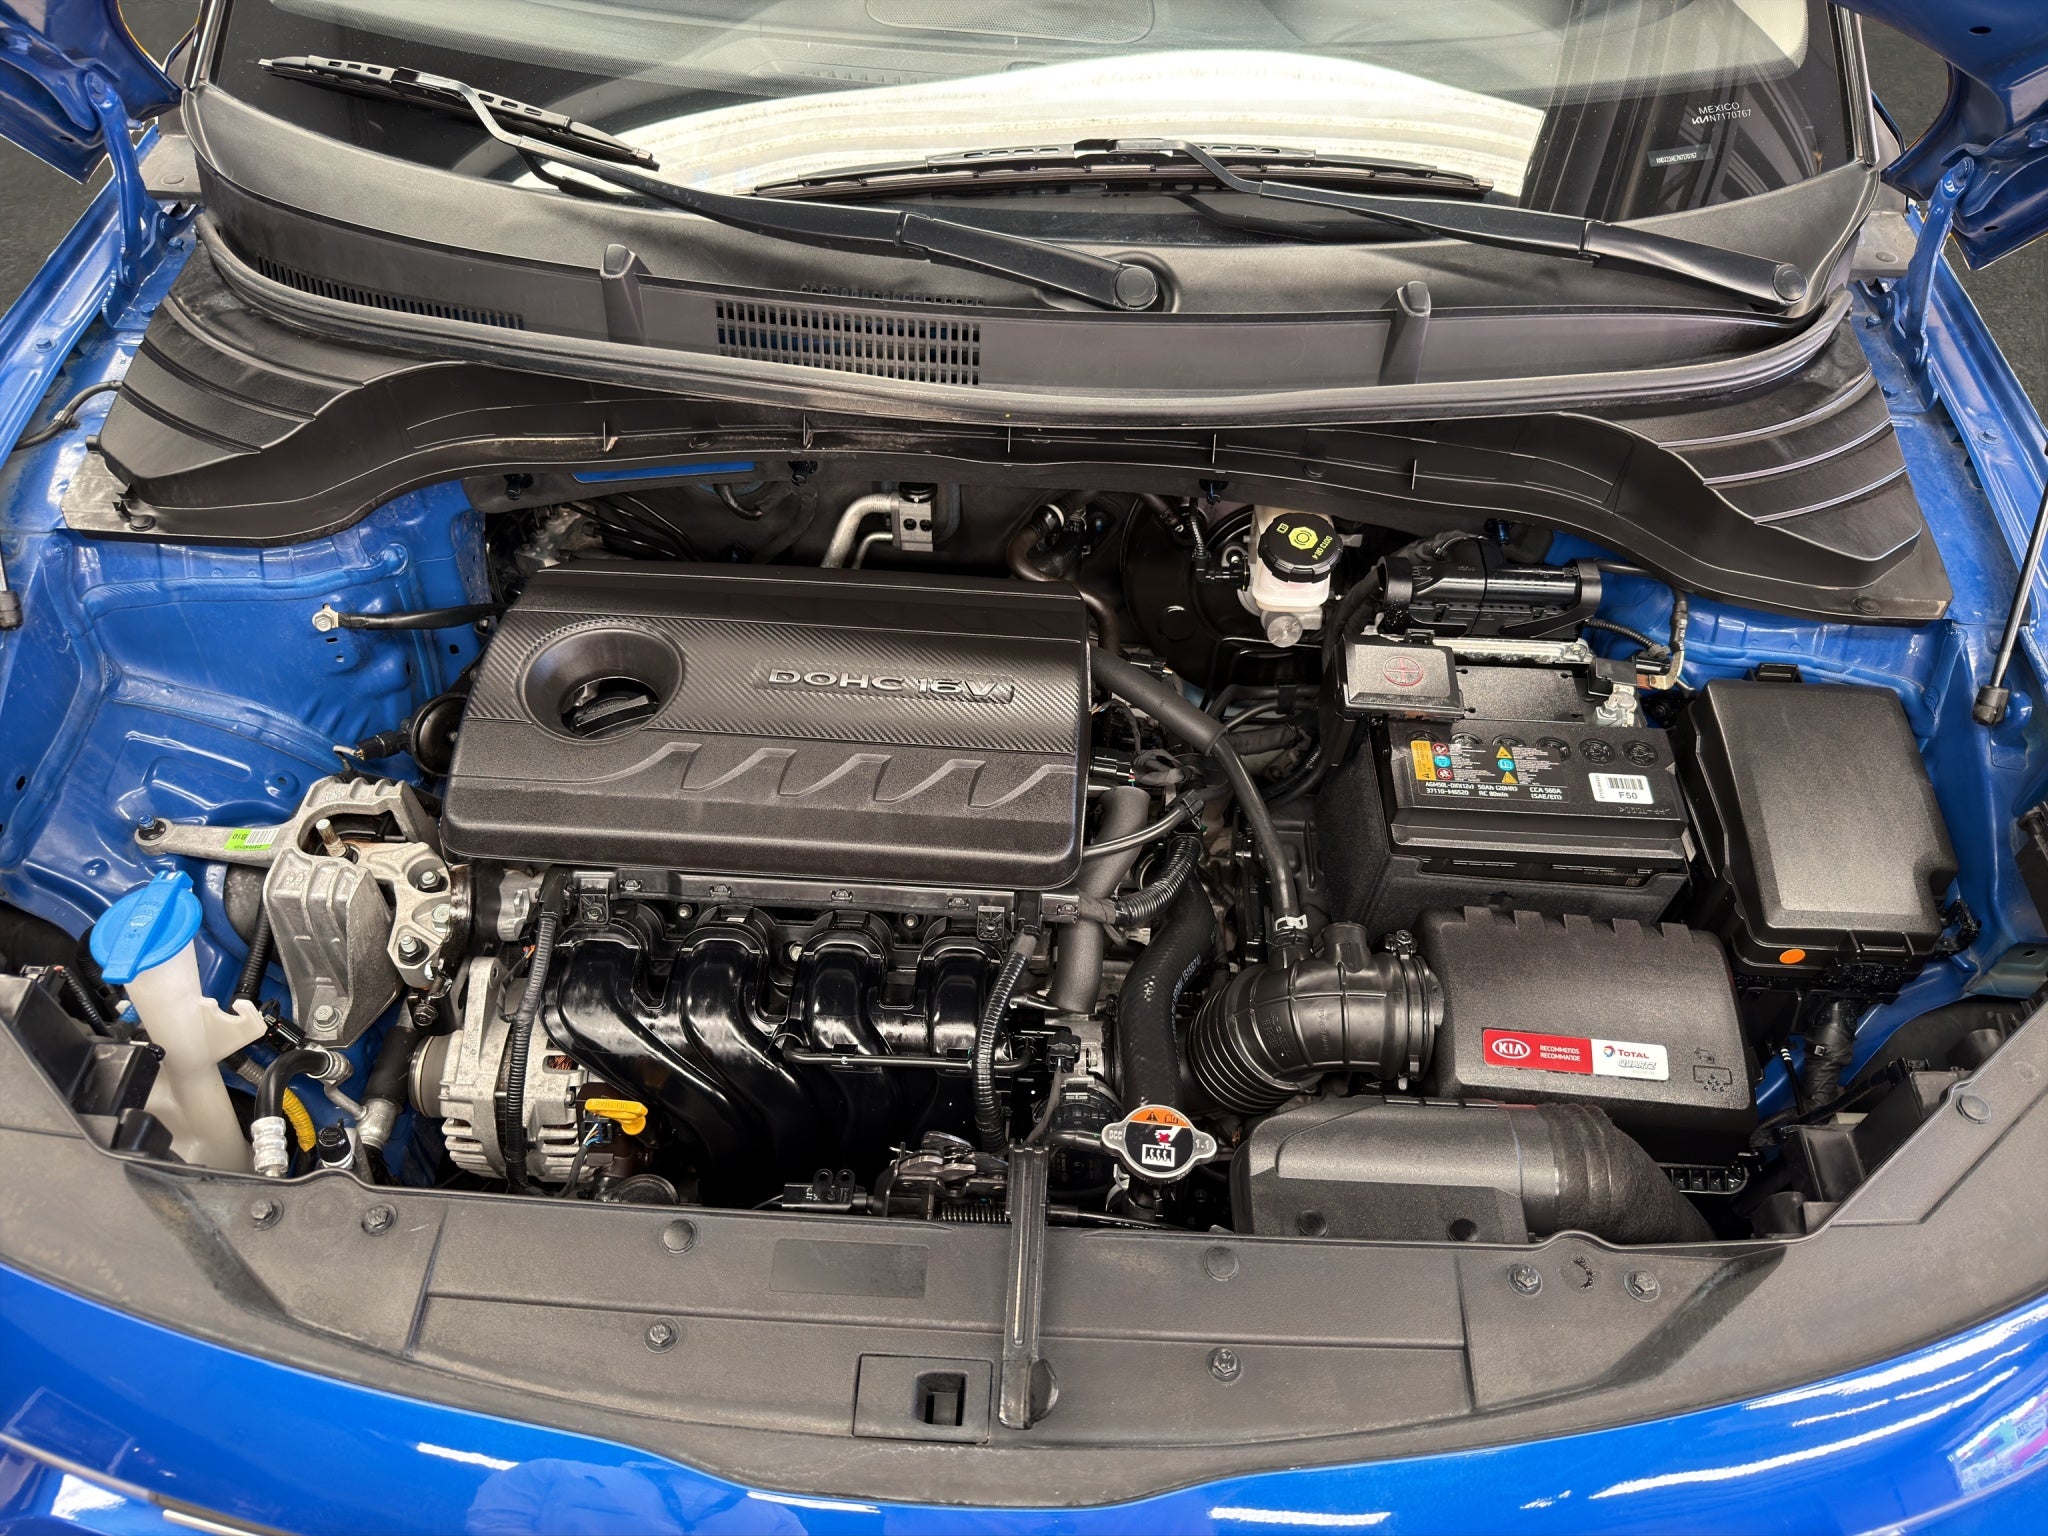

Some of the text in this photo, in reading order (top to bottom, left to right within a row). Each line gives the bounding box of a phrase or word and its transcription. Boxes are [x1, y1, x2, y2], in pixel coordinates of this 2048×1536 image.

[1698, 101, 1740, 115] MEXICO
[768, 668, 998, 699] DOHC 16V
[1619, 791, 1638, 800] F50
[1498, 1042, 1524, 1056] KIA
[1539, 1044, 1580, 1055] RECOMMENDS
[1540, 1052, 1581, 1061] RECOMMANDE
[1618, 1059, 1656, 1071] QUARTZ
[1108, 1129, 1210, 1150] DCC 1.1
